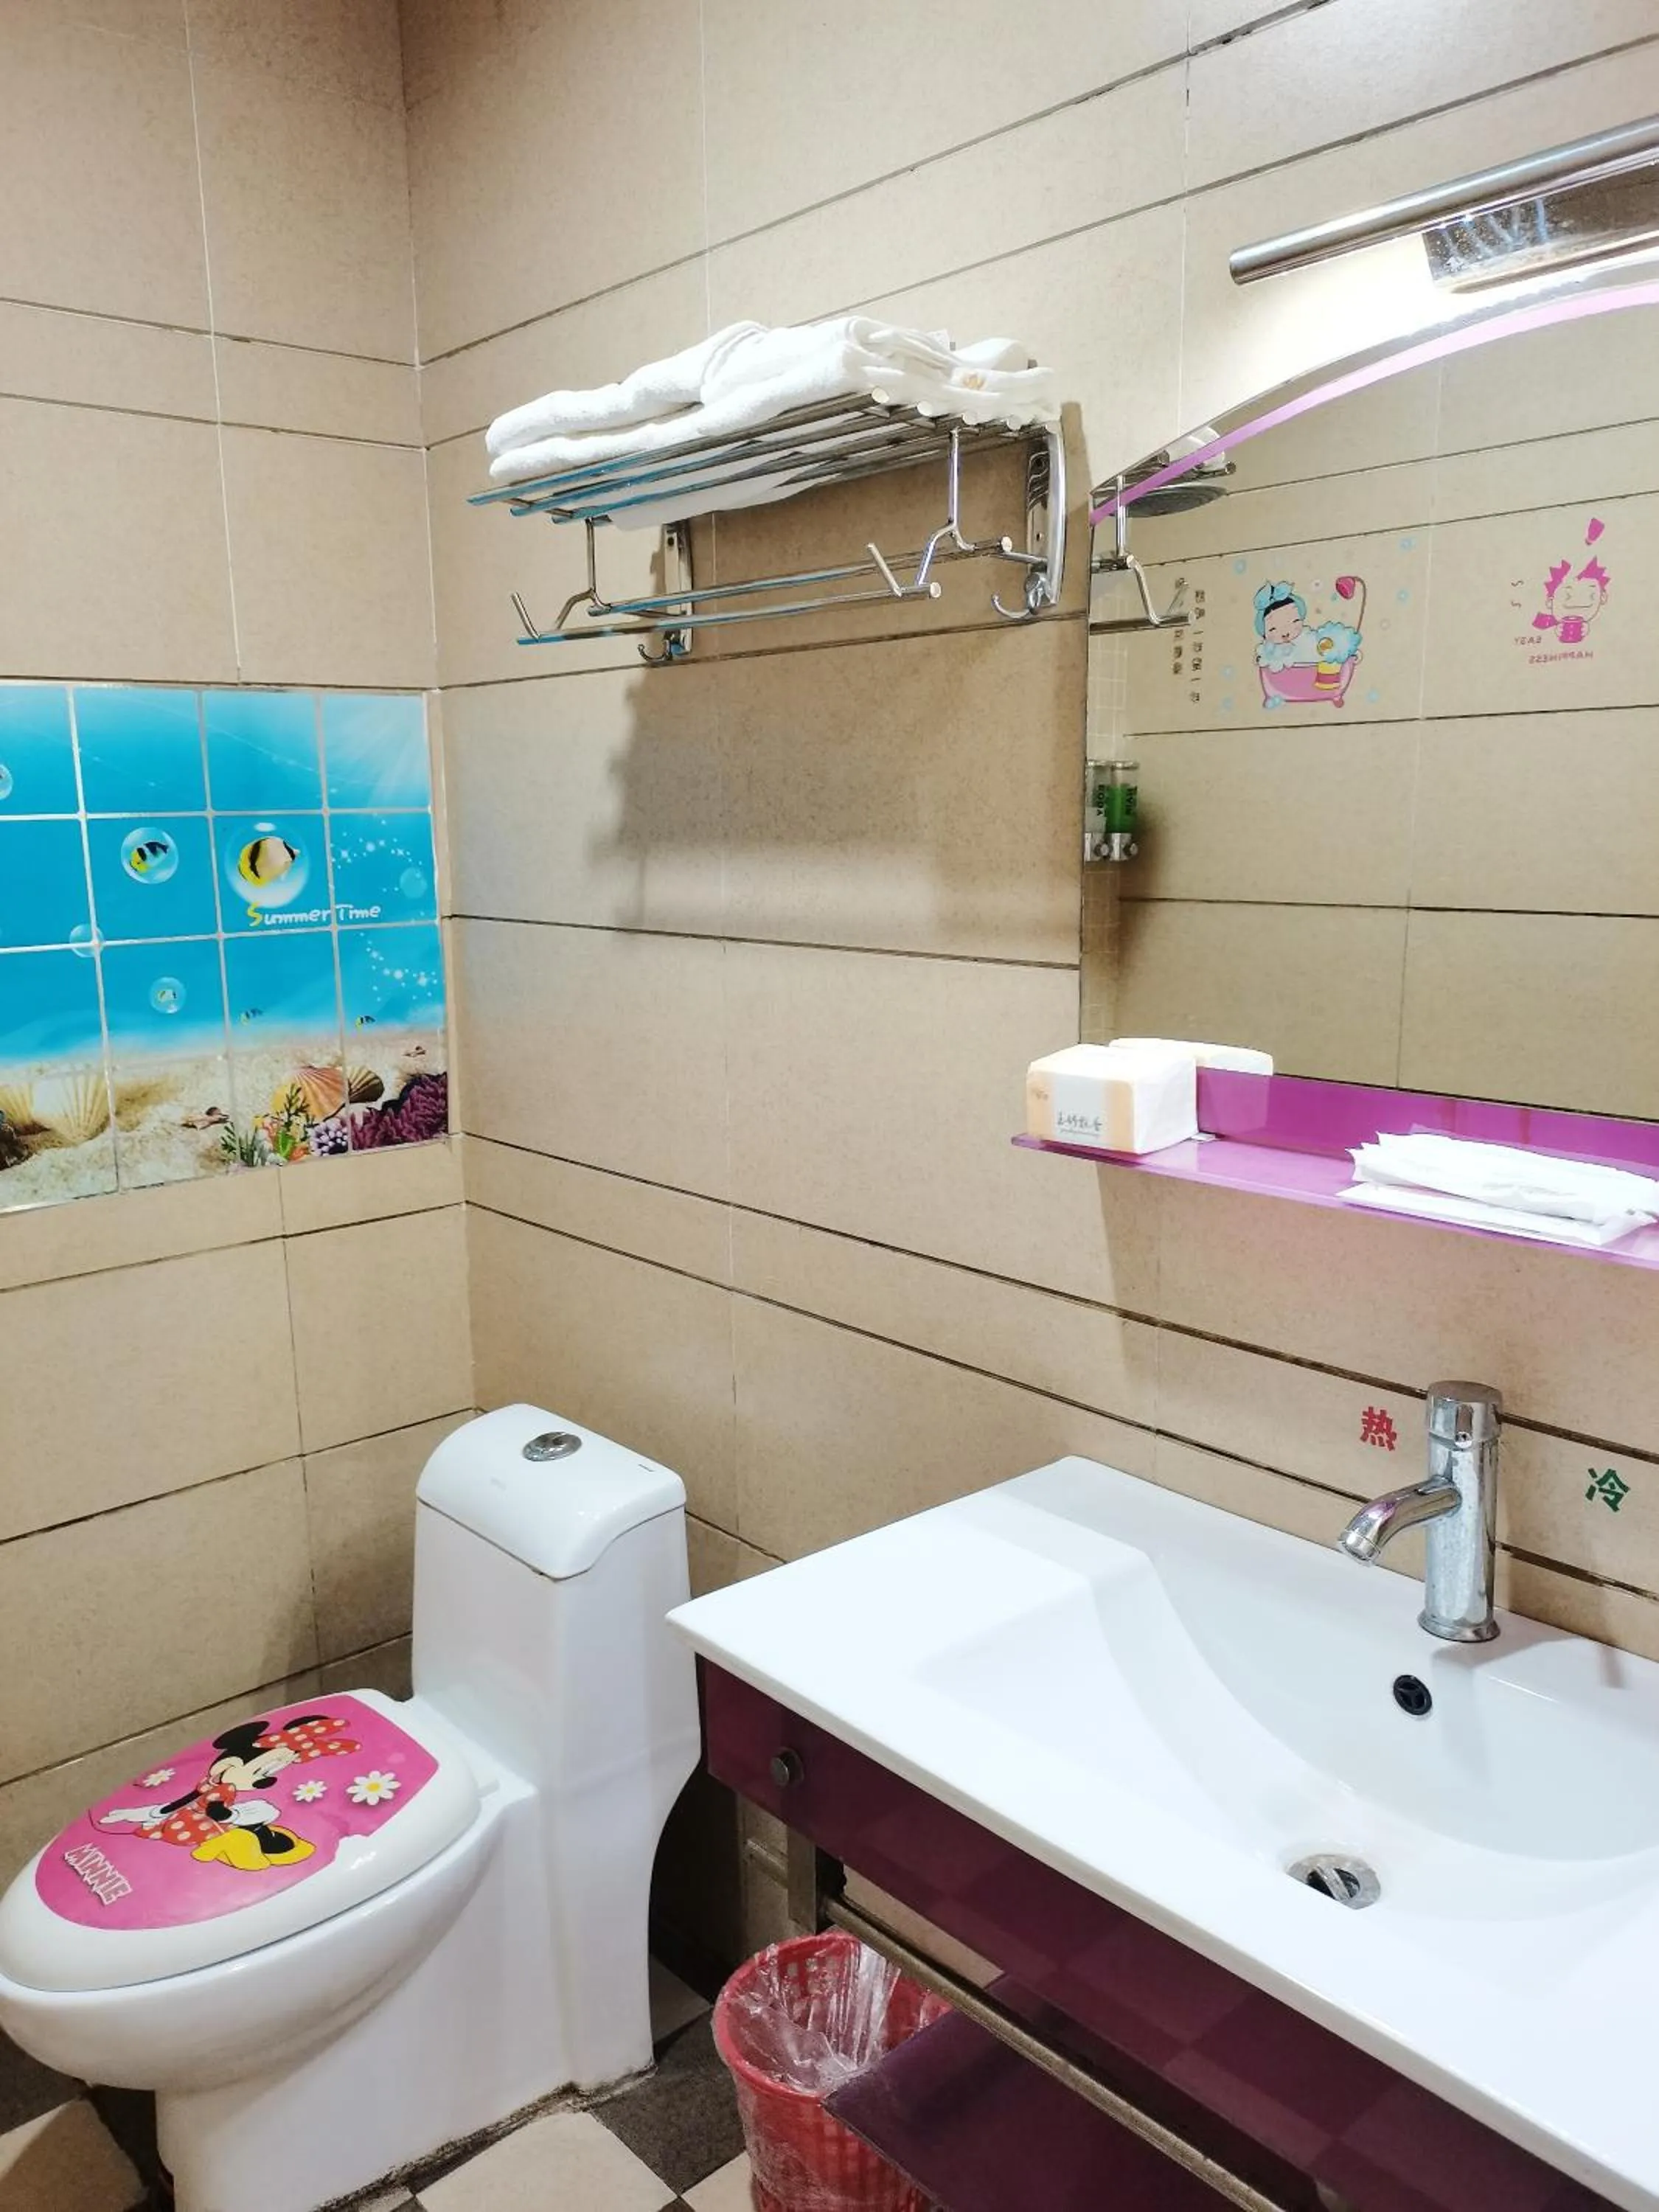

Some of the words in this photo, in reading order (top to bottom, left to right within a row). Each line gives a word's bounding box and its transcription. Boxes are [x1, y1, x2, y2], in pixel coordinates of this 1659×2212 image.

[1360, 1406, 1397, 1451] 热
[1585, 1468, 1630, 1512] 冷
[64, 1843, 133, 1906] MINNIE
